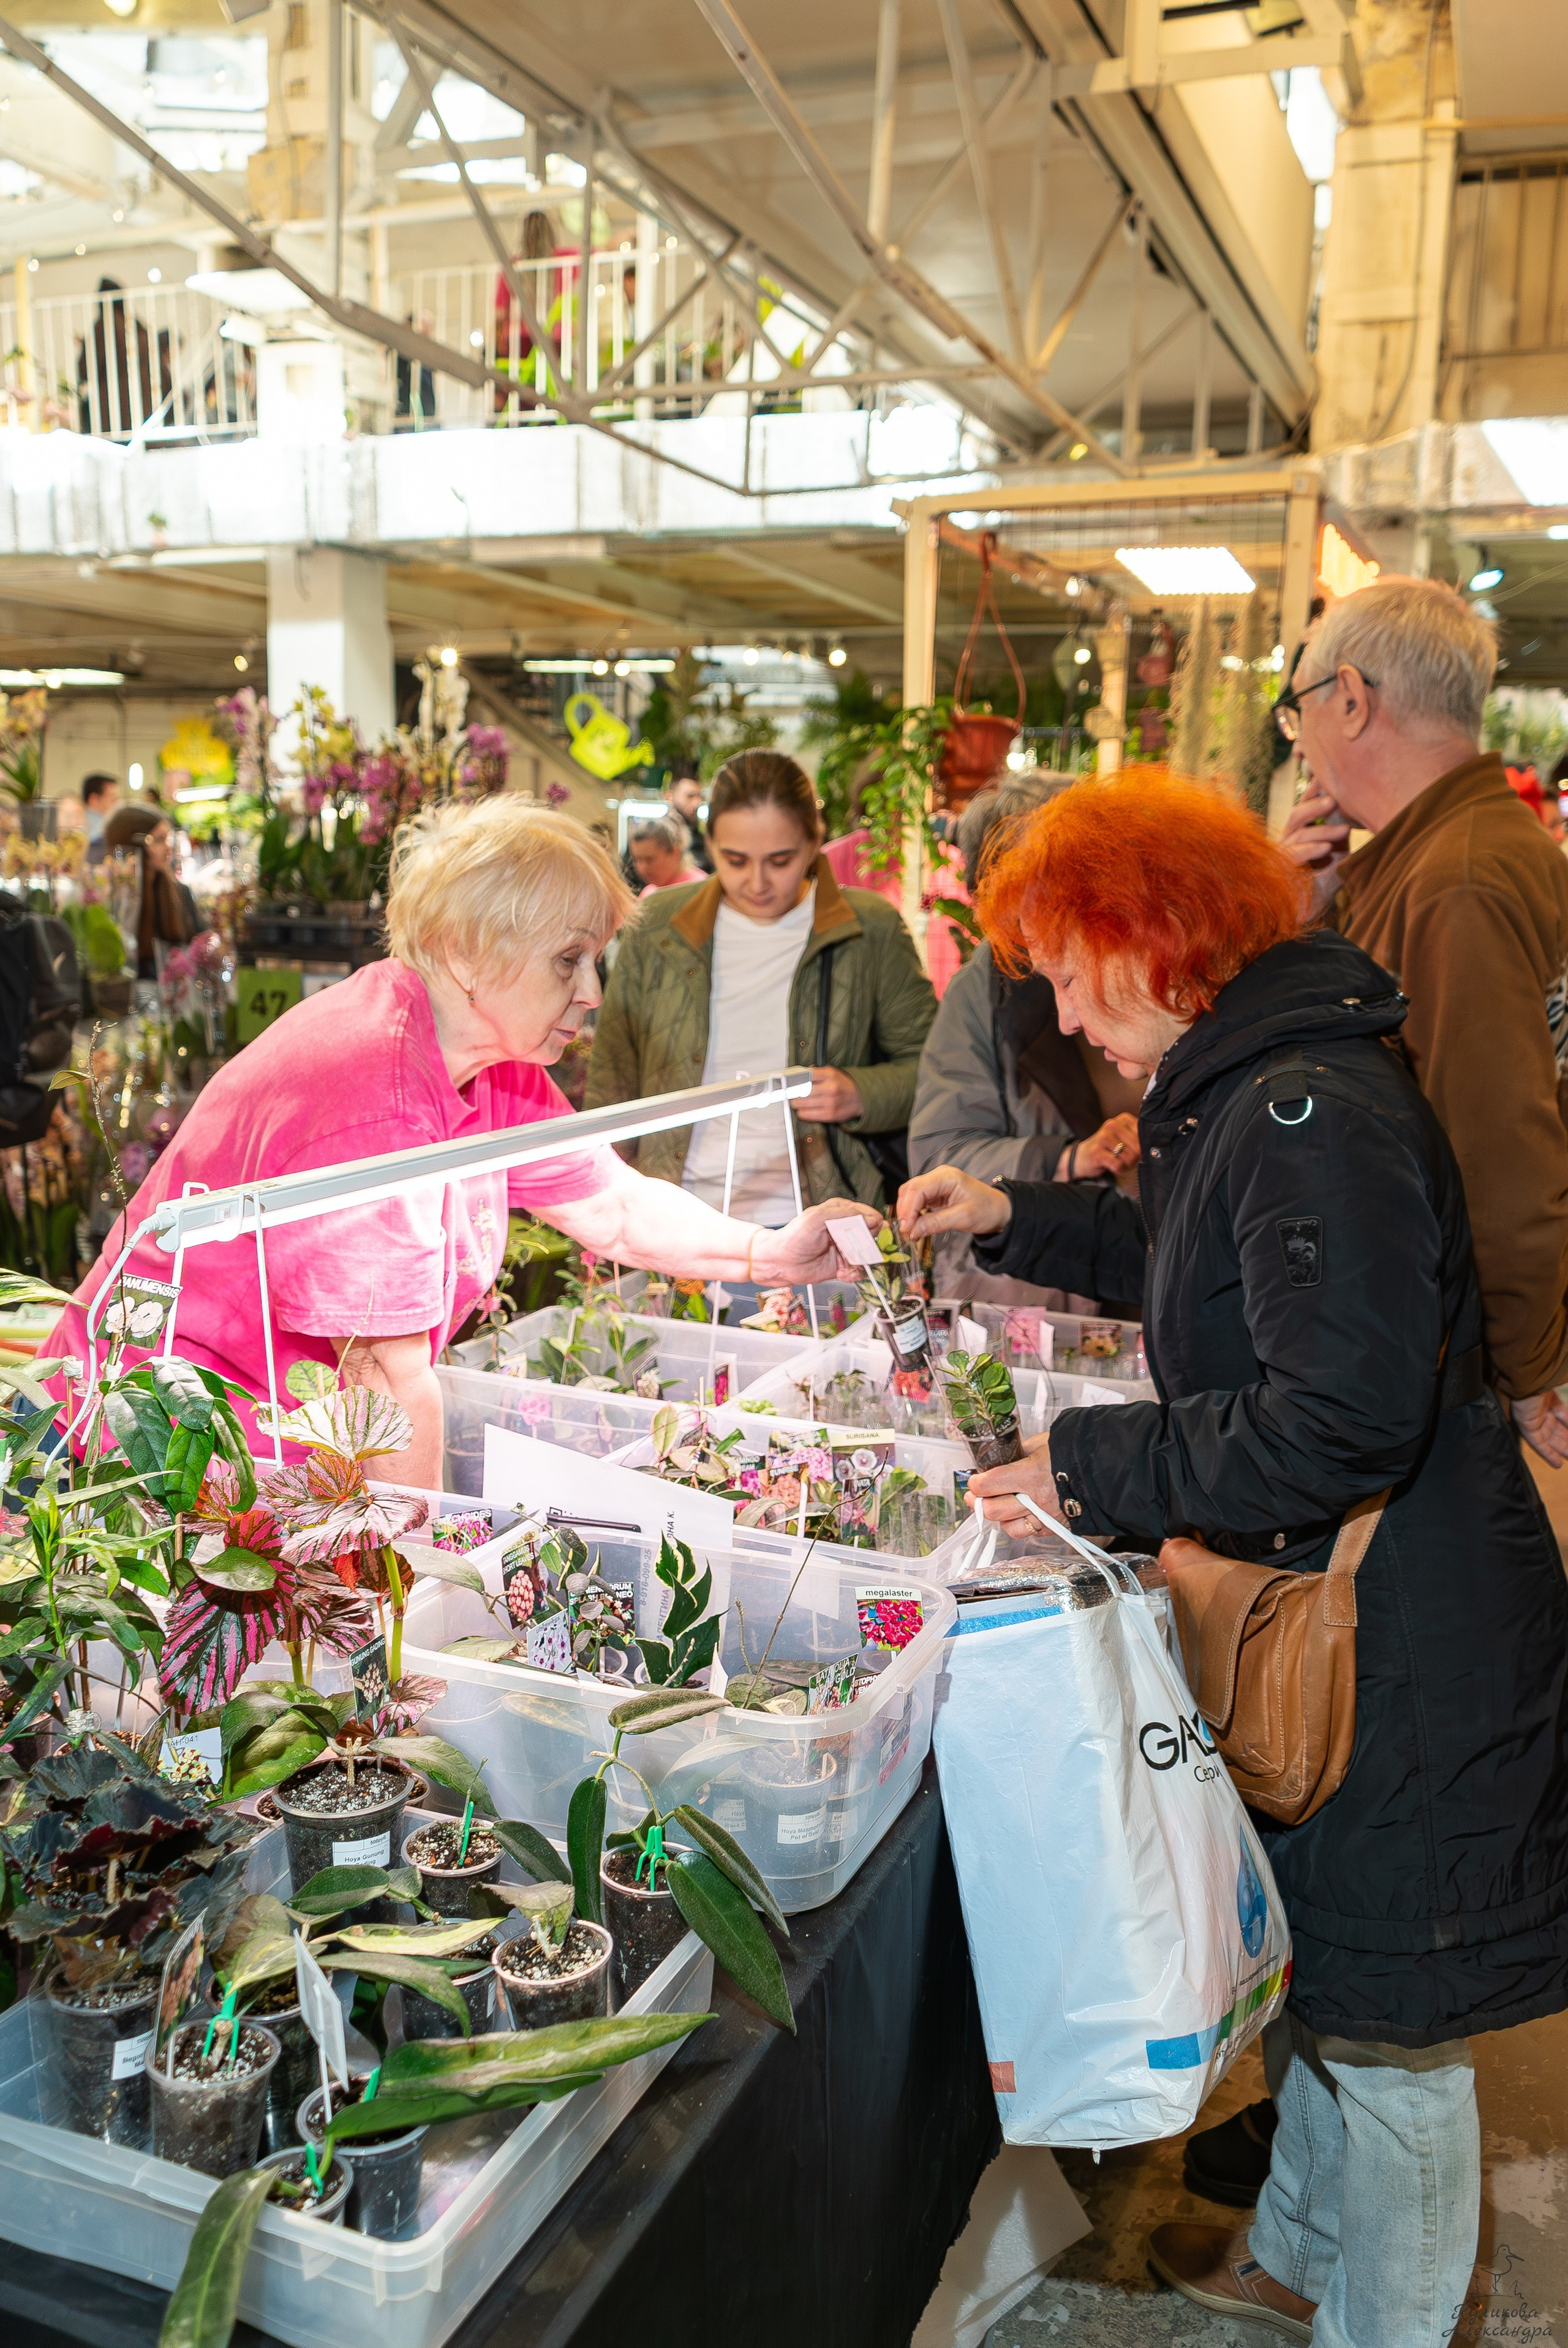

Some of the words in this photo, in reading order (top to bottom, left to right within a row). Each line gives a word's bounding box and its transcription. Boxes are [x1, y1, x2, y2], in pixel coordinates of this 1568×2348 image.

[250, 989, 288, 1017] 47
[865, 1589, 913, 1598] megalaster
[350, 1648, 370, 1666] GUNUNG
[369, 1637, 385, 1653] GADING
[816, 1658, 850, 1683] LATIOLIA
[835, 1667, 856, 1684] GOLD
[363, 1849, 385, 1860] Gunung
